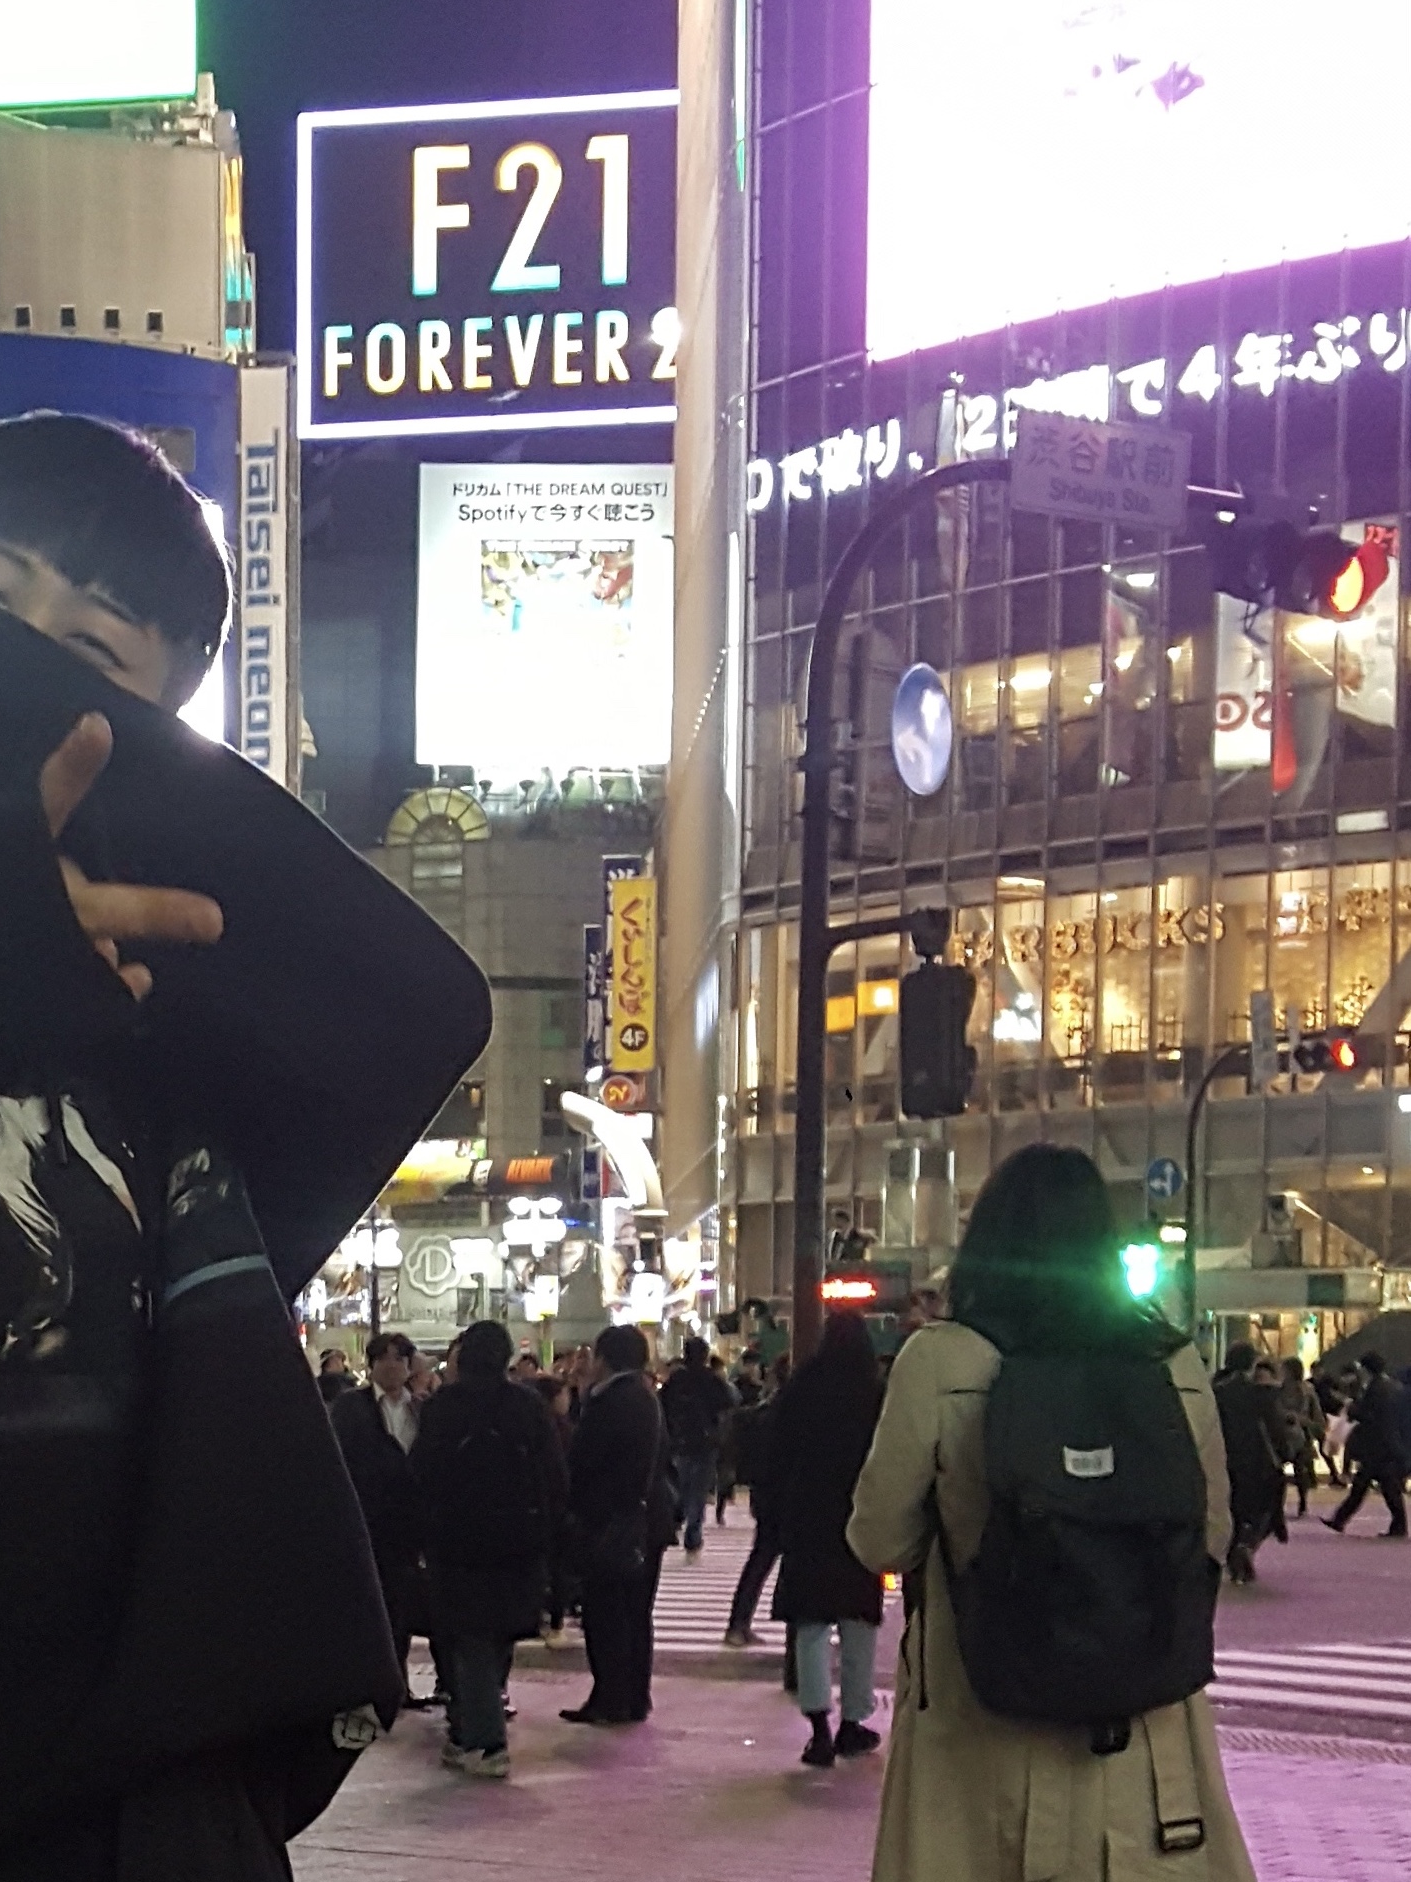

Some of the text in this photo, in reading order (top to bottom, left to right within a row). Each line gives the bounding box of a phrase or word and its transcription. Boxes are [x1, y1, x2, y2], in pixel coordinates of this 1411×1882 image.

[412, 134, 630, 297] F21
[323, 309, 630, 399] FOREVER
[244, 426, 281, 608] Taisei
[548, 482, 606, 497] DREAM
[621, 1025, 647, 1047] 4F
